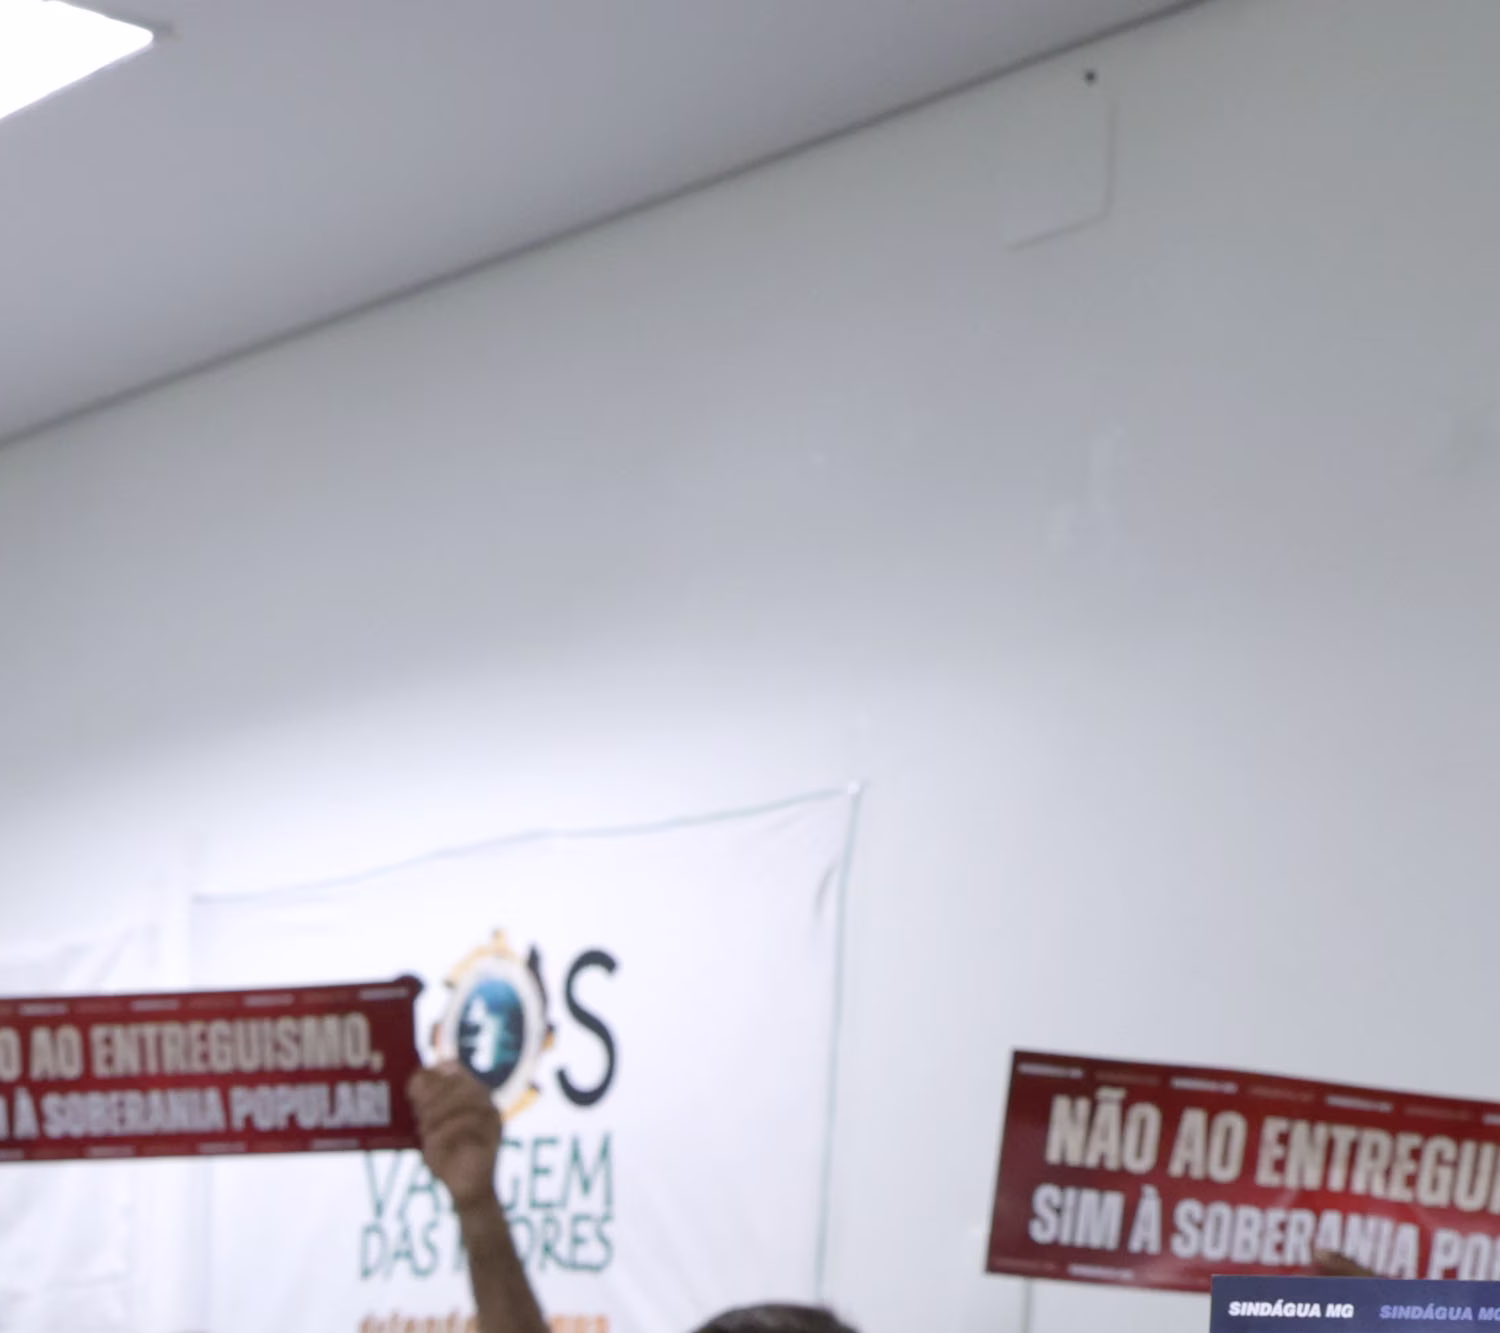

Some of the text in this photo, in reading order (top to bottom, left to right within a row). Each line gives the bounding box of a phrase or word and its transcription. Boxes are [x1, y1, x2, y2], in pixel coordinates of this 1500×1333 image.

[30, 1024, 84, 1080] AO
[91, 1013, 383, 1078] ENTREGUISMO,
[42, 1087, 225, 1137] SOBERANIA
[230, 1082, 390, 1131] POPULAR!
[1046, 1086, 1161, 1176] NÃO
[1168, 1108, 1248, 1184] AO
[363, 1132, 615, 1220] VAGEM
[1030, 1184, 1419, 1279] SIM À SOBERANIA
[1229, 1299, 1354, 1319] SINDÁGUA MG
